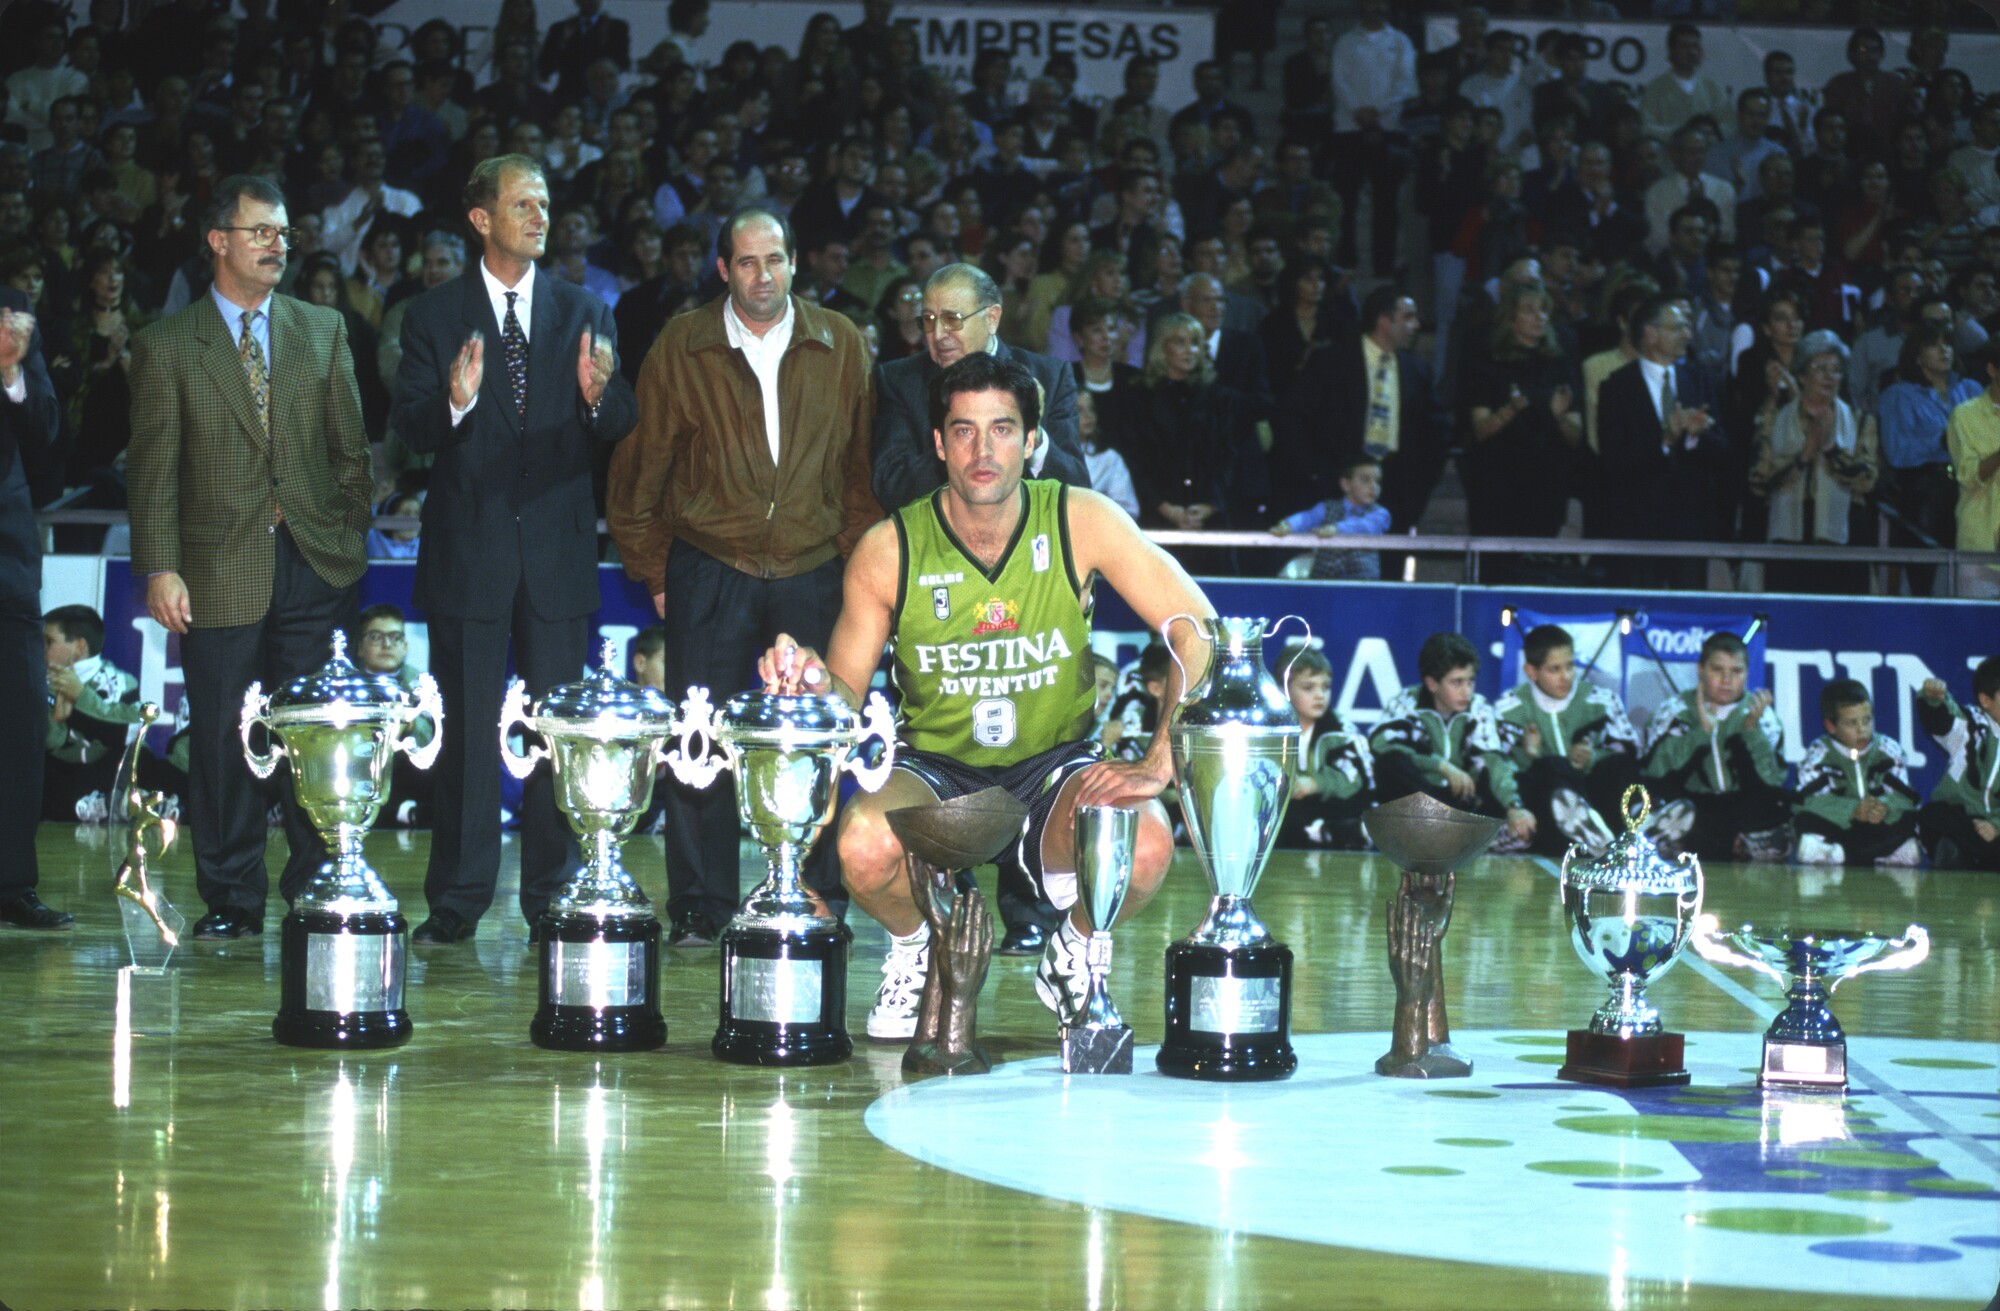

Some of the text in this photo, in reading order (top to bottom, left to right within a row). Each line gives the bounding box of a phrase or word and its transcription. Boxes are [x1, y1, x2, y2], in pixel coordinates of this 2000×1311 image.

[893, 18, 1181, 61] MPRESAS
[915, 628, 1072, 673] FESTINA
[972, 698, 1016, 746] 8
